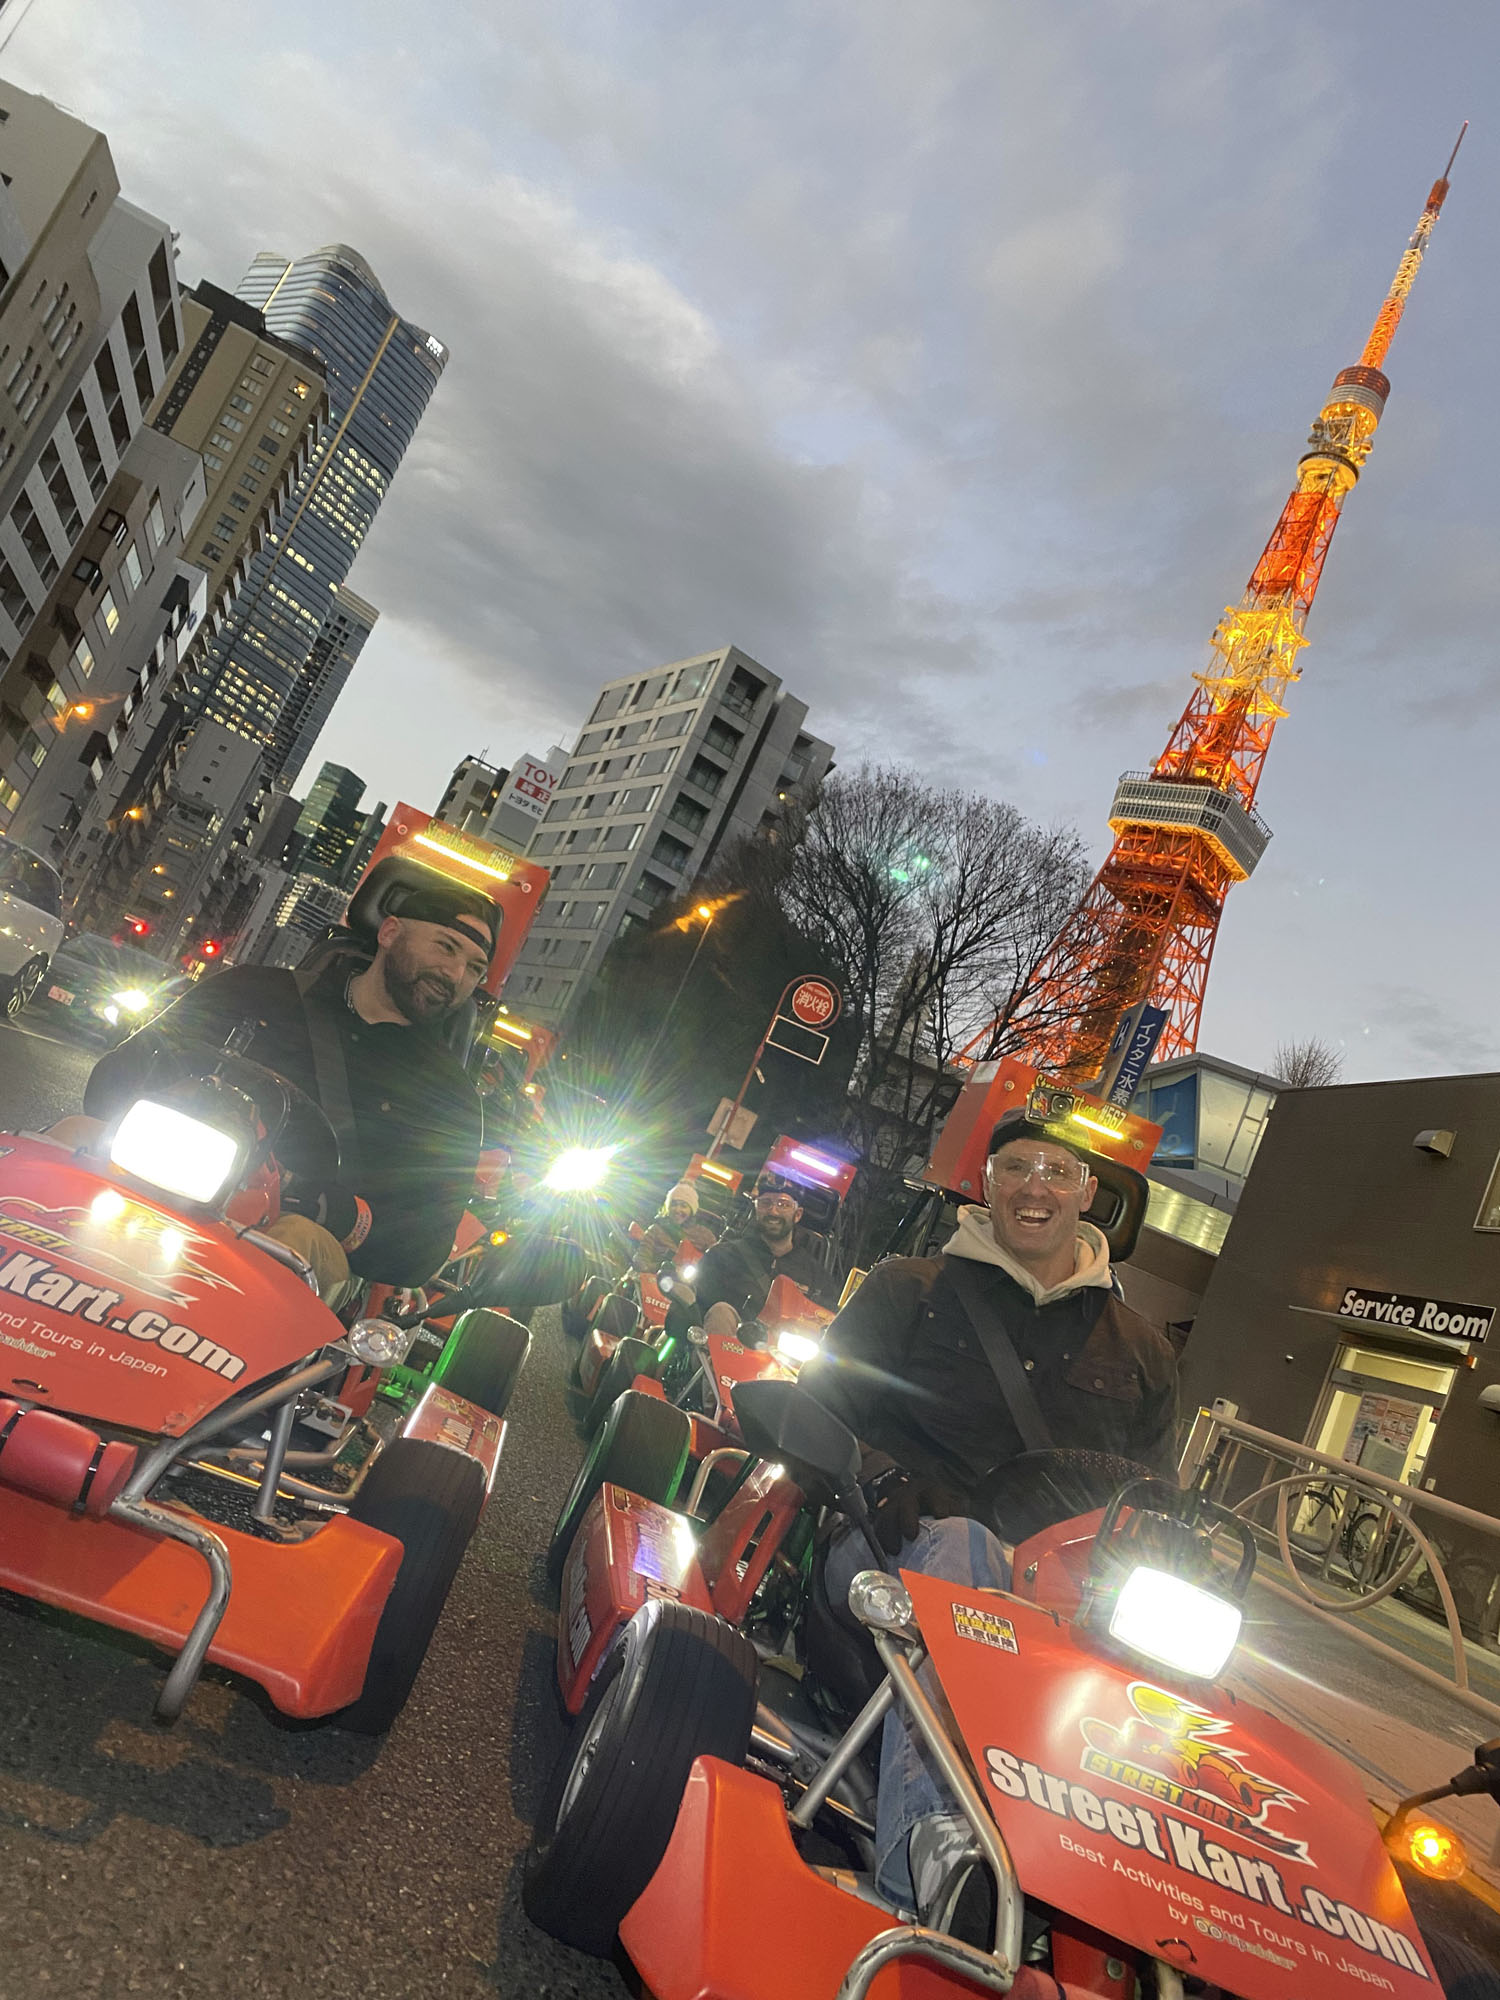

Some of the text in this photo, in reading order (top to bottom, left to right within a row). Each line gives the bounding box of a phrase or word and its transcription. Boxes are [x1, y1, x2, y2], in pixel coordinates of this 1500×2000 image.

[796, 989, 830, 1016] 消火栓
[1111, 1023, 1156, 1108] イワタニ水素
[1099, 1104, 1127, 1131] #567
[1340, 1289, 1489, 1339] Service Room
[0, 1311, 169, 1378] nd Tours in Japan
[985, 1746, 1169, 1862] Street
[1059, 1834, 1395, 1993] Best Activities and Tours in Japan
[1168, 1904, 1189, 1925] by
